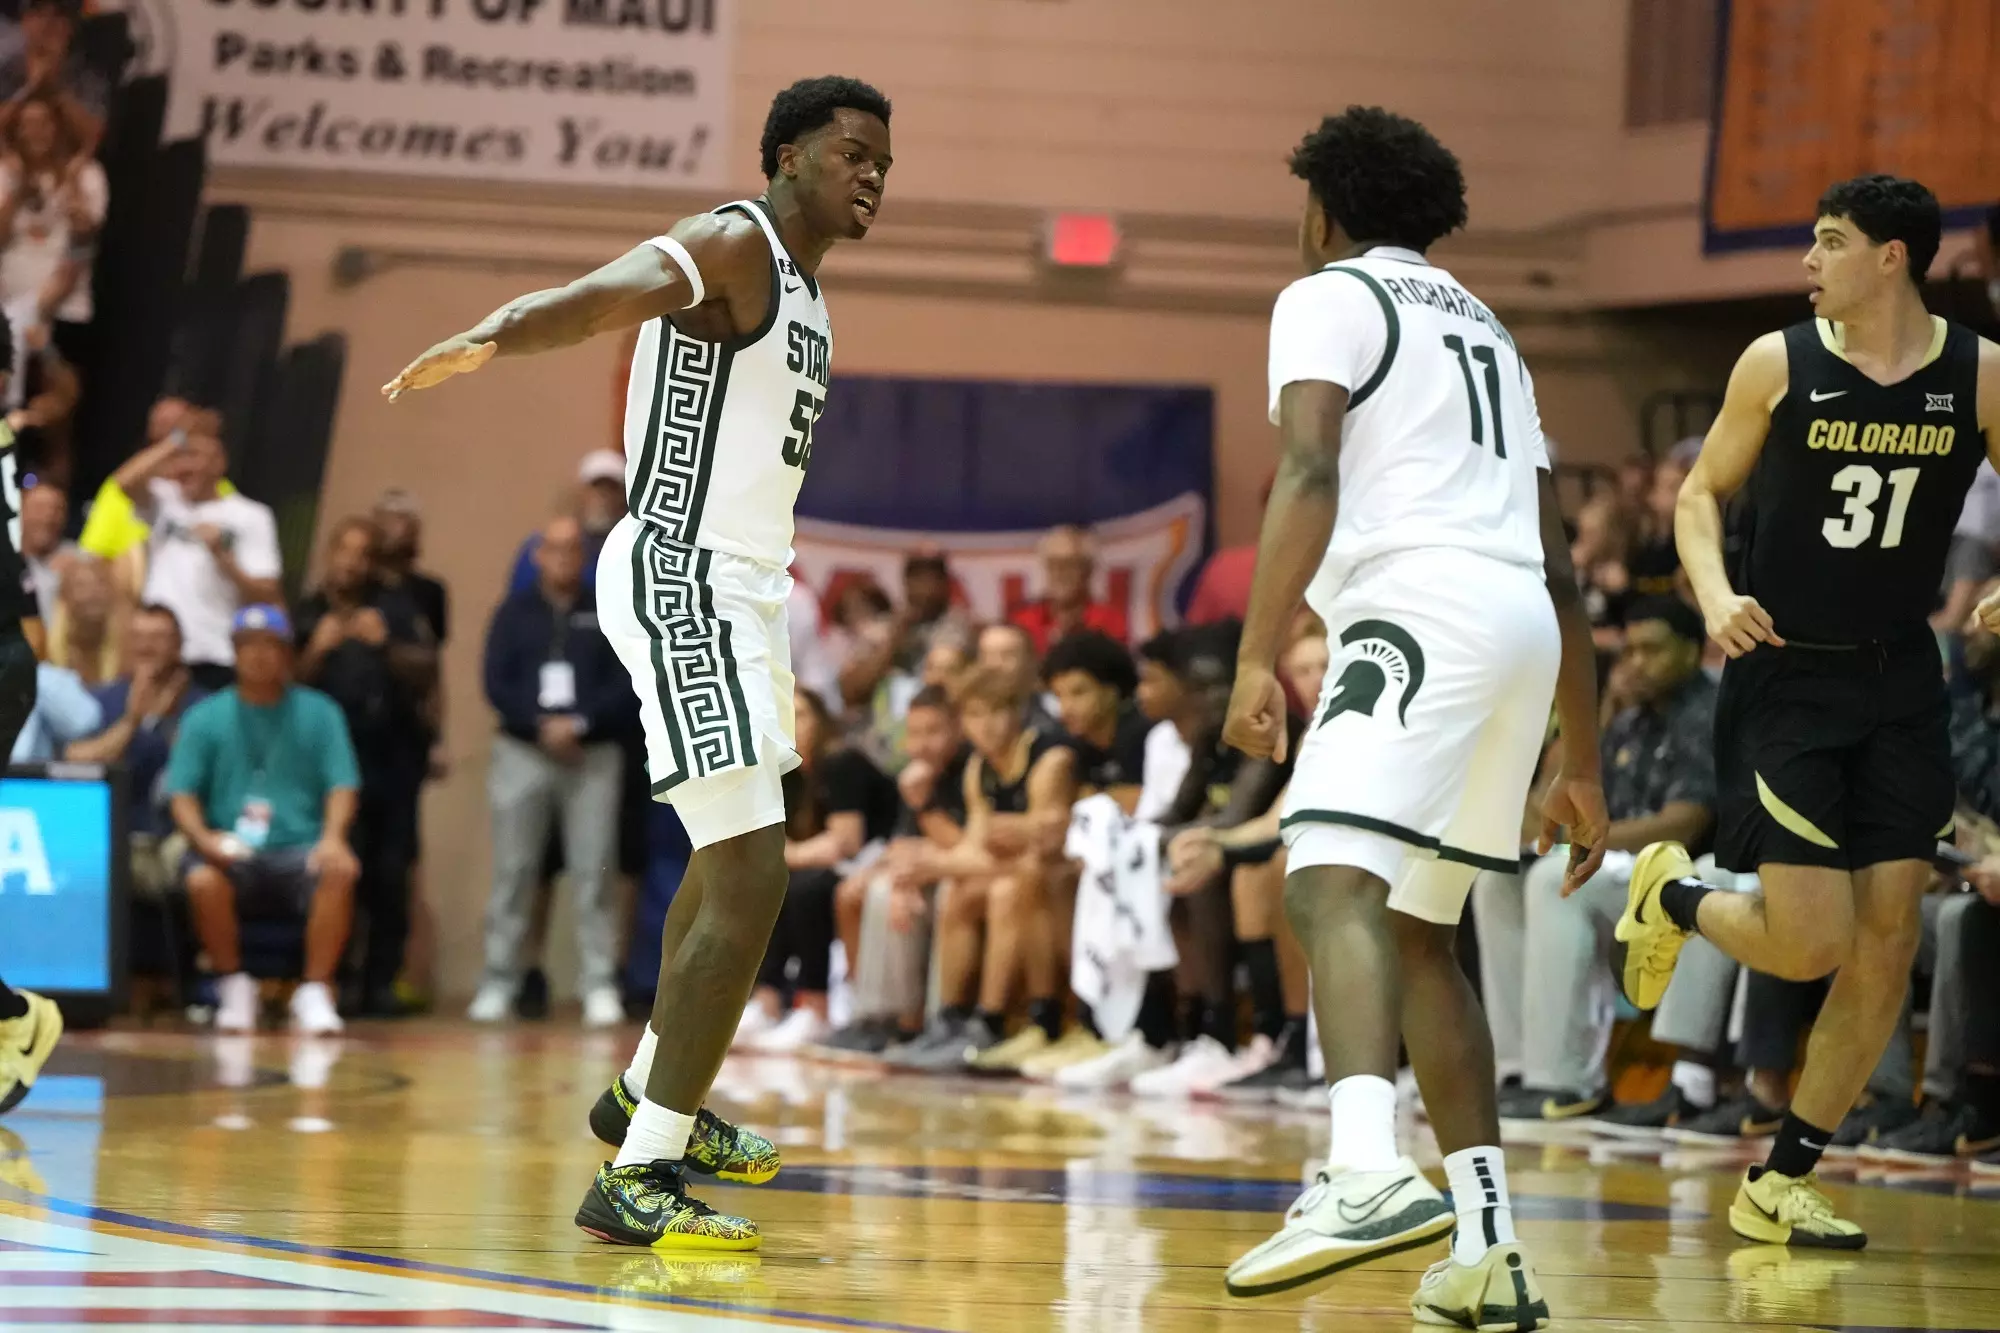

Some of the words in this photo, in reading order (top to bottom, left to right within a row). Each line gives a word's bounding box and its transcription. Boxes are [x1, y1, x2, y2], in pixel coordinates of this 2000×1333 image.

[213, 32, 359, 78] Parks
[373, 42, 404, 80] &
[422, 46, 695, 96] Recreation
[203, 98, 526, 161] Welcomes
[557, 118, 709, 174] You!
[787, 320, 830, 387] STAT
[1443, 333, 1507, 459] 11
[1807, 418, 1956, 456] COLORADO
[1821, 464, 1921, 549] 31
